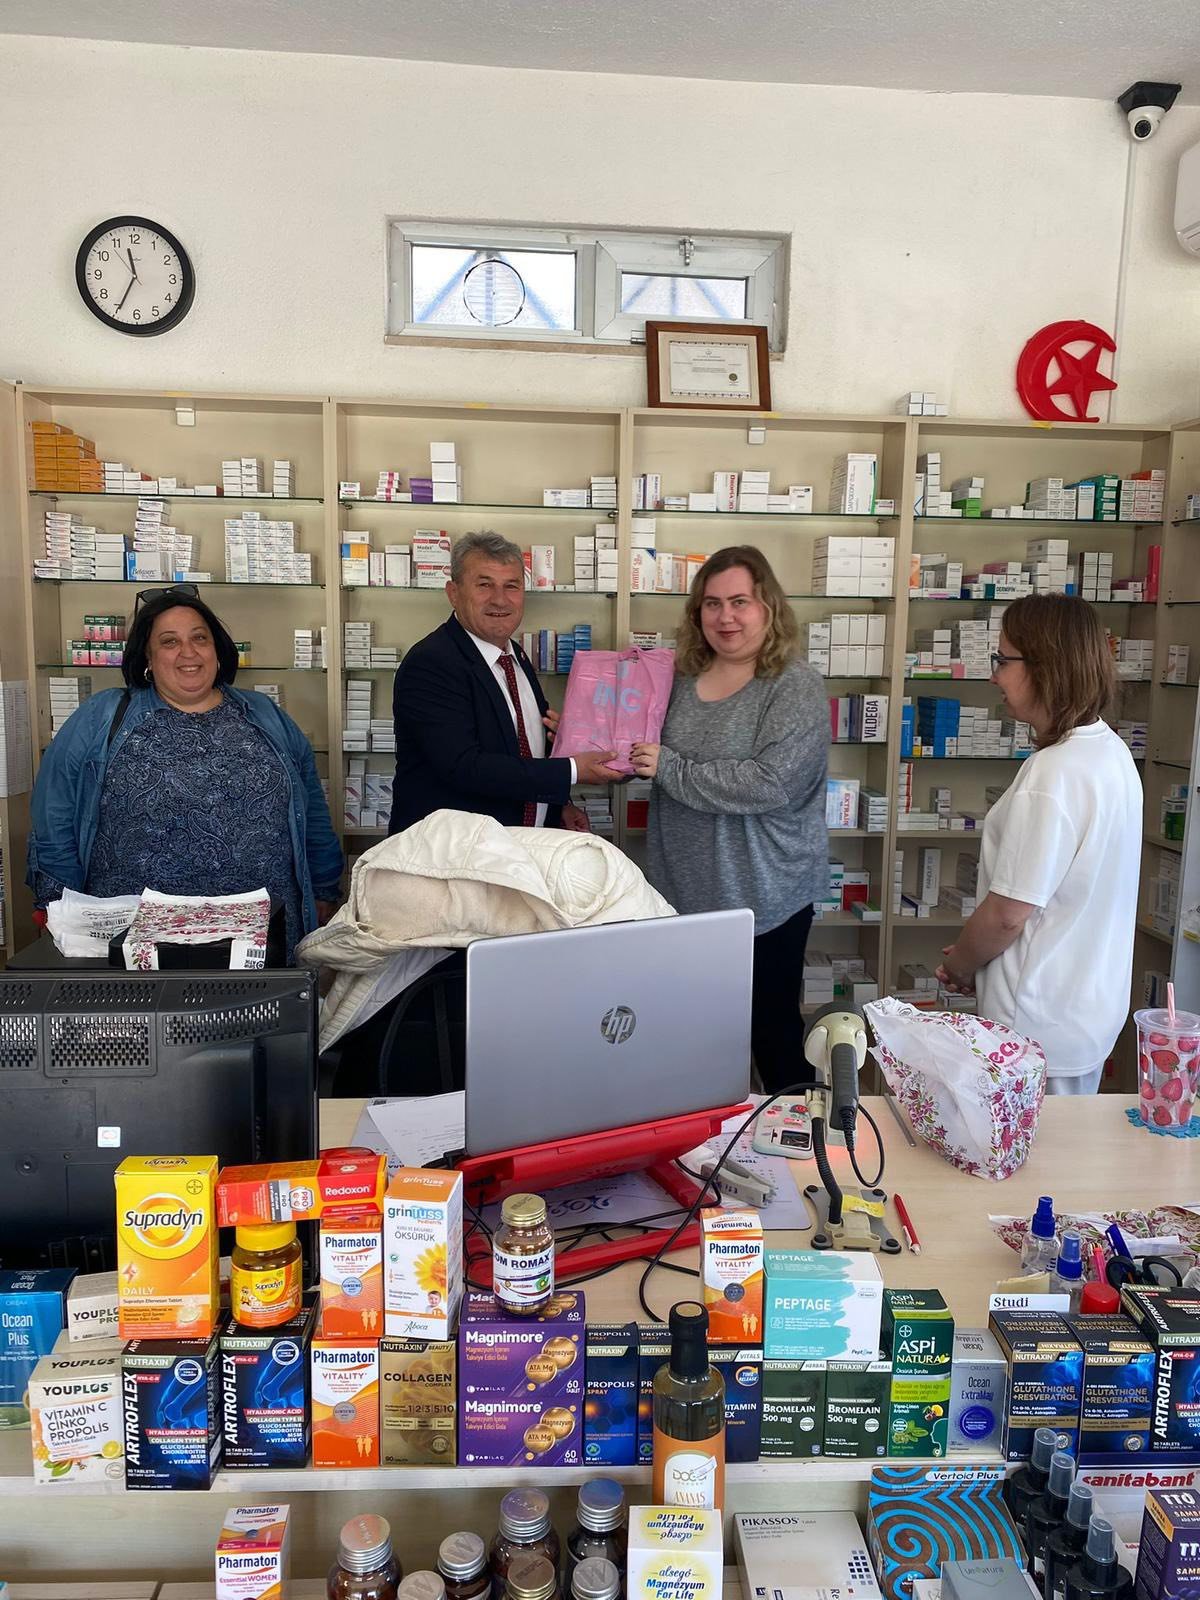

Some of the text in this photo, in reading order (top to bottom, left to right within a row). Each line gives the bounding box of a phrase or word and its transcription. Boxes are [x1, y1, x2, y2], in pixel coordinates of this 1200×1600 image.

[112, 238, 121, 248] 11
[129, 234, 141, 244] 12
[152, 241, 156, 251] 1
[97, 250, 110, 262] 10
[164, 255, 171, 266] 2
[94, 269, 102, 280] 9
[168, 274, 177, 285] 3
[99, 288, 109, 299] 8
[164, 293, 173, 303] 4
[114, 303, 121, 314] 7
[151, 306, 160, 317] 5
[133, 309, 141, 320] 6
[864, 700, 879, 739] VILDEGA
[604, 1006, 633, 1044] hp
[325, 1185, 370, 1196] Redoxon
[387, 1204, 444, 1220] grinTuss
[124, 1208, 203, 1230] Supradyn
[325, 1236, 377, 1248] Pharmaton
[709, 1242, 760, 1254] Pharmaton
[768, 1254, 814, 1262] PEPTAGE
[255, 1279, 284, 1291] Supradyn
[123, 1287, 154, 1295] DAILY
[774, 1298, 831, 1312] PEPTAGE
[993, 1296, 1029, 1308] Studi
[2, 1313, 33, 1328] Ocean
[404, 1321, 428, 1333] Aboca
[8, 1332, 29, 1346] Plus
[466, 1330, 543, 1347] Magnimore
[383, 1342, 424, 1351] NUTRAXIN
[543, 1348, 575, 1356] Magnezyum
[124, 1358, 169, 1366] NUTRAXIN
[313, 1350, 375, 1363] Pharmaton
[896, 1354, 940, 1364] NATURA
[1015, 1353, 1053, 1361] NUTRAXIN
[51, 1358, 117, 1369] YOUPLUS
[543, 1364, 554, 1372] Mg
[322, 1372, 365, 1380] VITALITY
[383, 1372, 452, 1382] COLLAGEN
[566, 1380, 579, 1388] 60
[968, 1376, 991, 1388] Ocean
[42, 1382, 110, 1396] YOUPLUS
[1013, 1385, 1075, 1393] GLUTATHIONE
[1085, 1388, 1147, 1396] GLUTATHIONE
[1154, 1349, 1174, 1438] ARTROFLEX
[222, 1353, 238, 1445] ARTROFLEX
[1012, 1393, 1078, 1401] +RESVERATROL
[1085, 1396, 1150, 1404] +RESVERATROL
[98, 1402, 108, 1412] C
[465, 1400, 542, 1416] Magnimore
[763, 1403, 816, 1413] BROMELAIN
[828, 1404, 881, 1414] BROMELAIN
[123, 1371, 141, 1466] ARTROFLEX
[542, 1419, 573, 1427] Magnezyum
[763, 1414, 793, 1424] 500 mg
[827, 1414, 858, 1425] 500 mg
[564, 1450, 577, 1458] 60
[933, 1472, 974, 1480] Vertoid
[1082, 1472, 1195, 1487] sanitabant
[674, 1491, 706, 1504] ANANAS
[236, 1506, 279, 1514] Pharmaton
[657, 1513, 694, 1521] Life For
[741, 1517, 798, 1527] PIKASSOS
[218, 1555, 278, 1569] Pharmaton
[247, 1574, 278, 1582] WOMEN
[646, 1579, 705, 1590] Magnezyum
[656, 1590, 694, 1600] For Life
